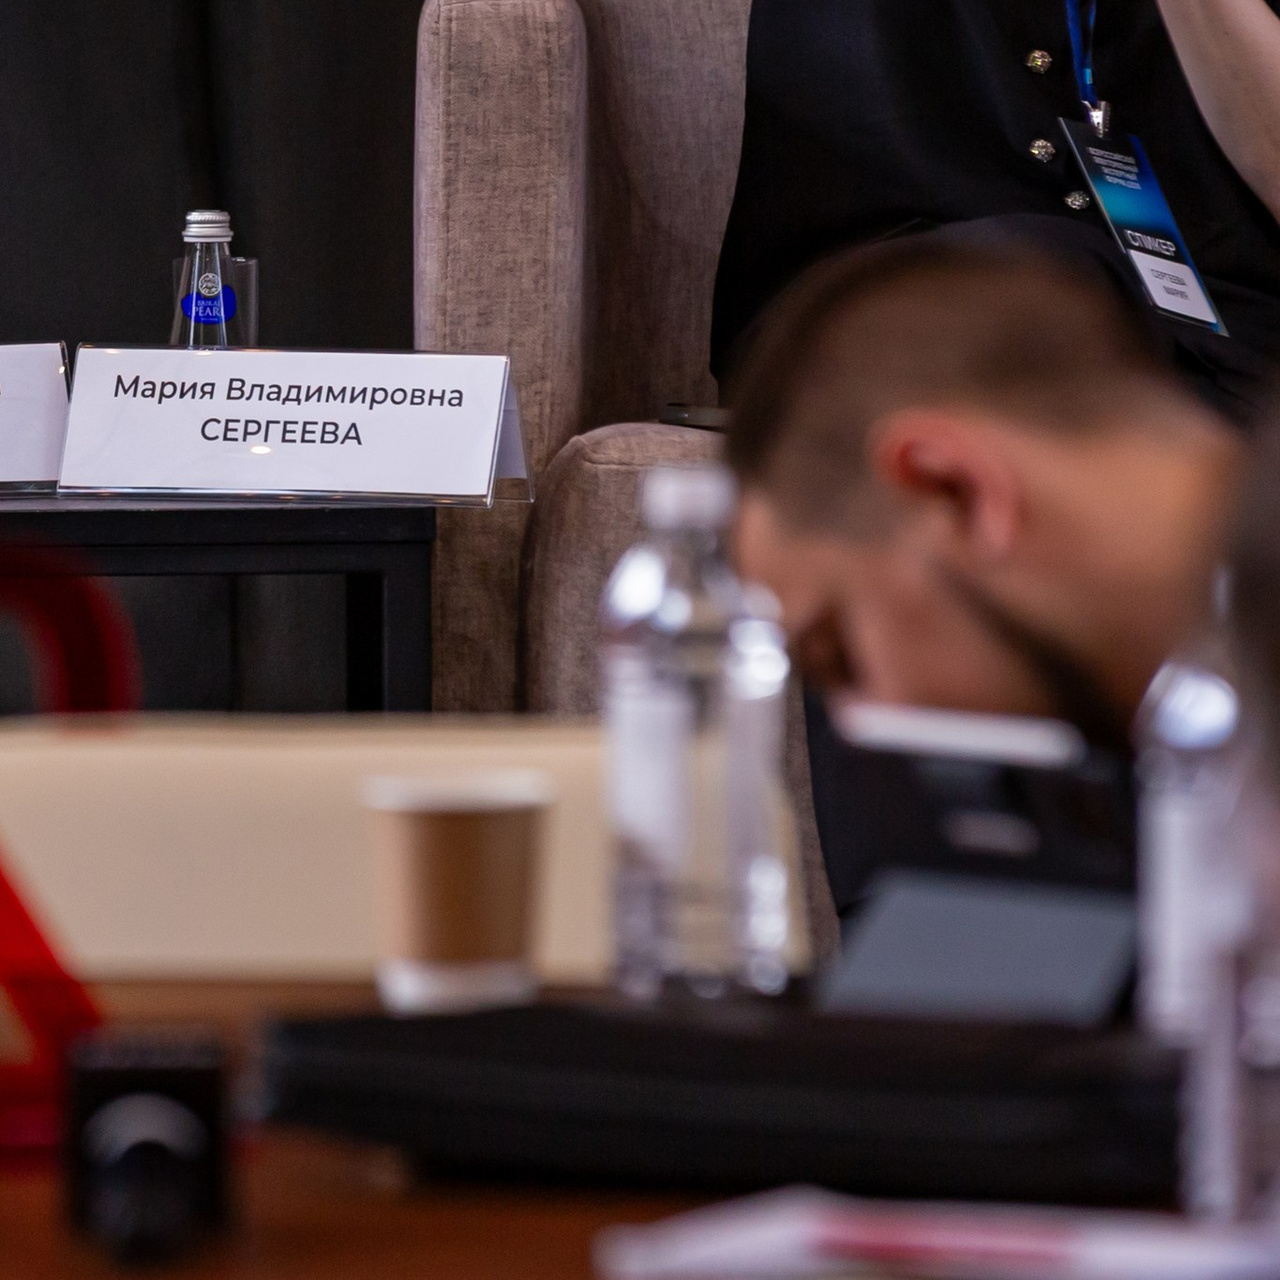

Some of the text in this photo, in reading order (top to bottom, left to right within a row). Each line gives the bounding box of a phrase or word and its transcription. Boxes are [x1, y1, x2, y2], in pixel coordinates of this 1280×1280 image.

[113, 374, 463, 411] Мария Владимировна
[200, 417, 362, 446] СЕРГЕЕВА
